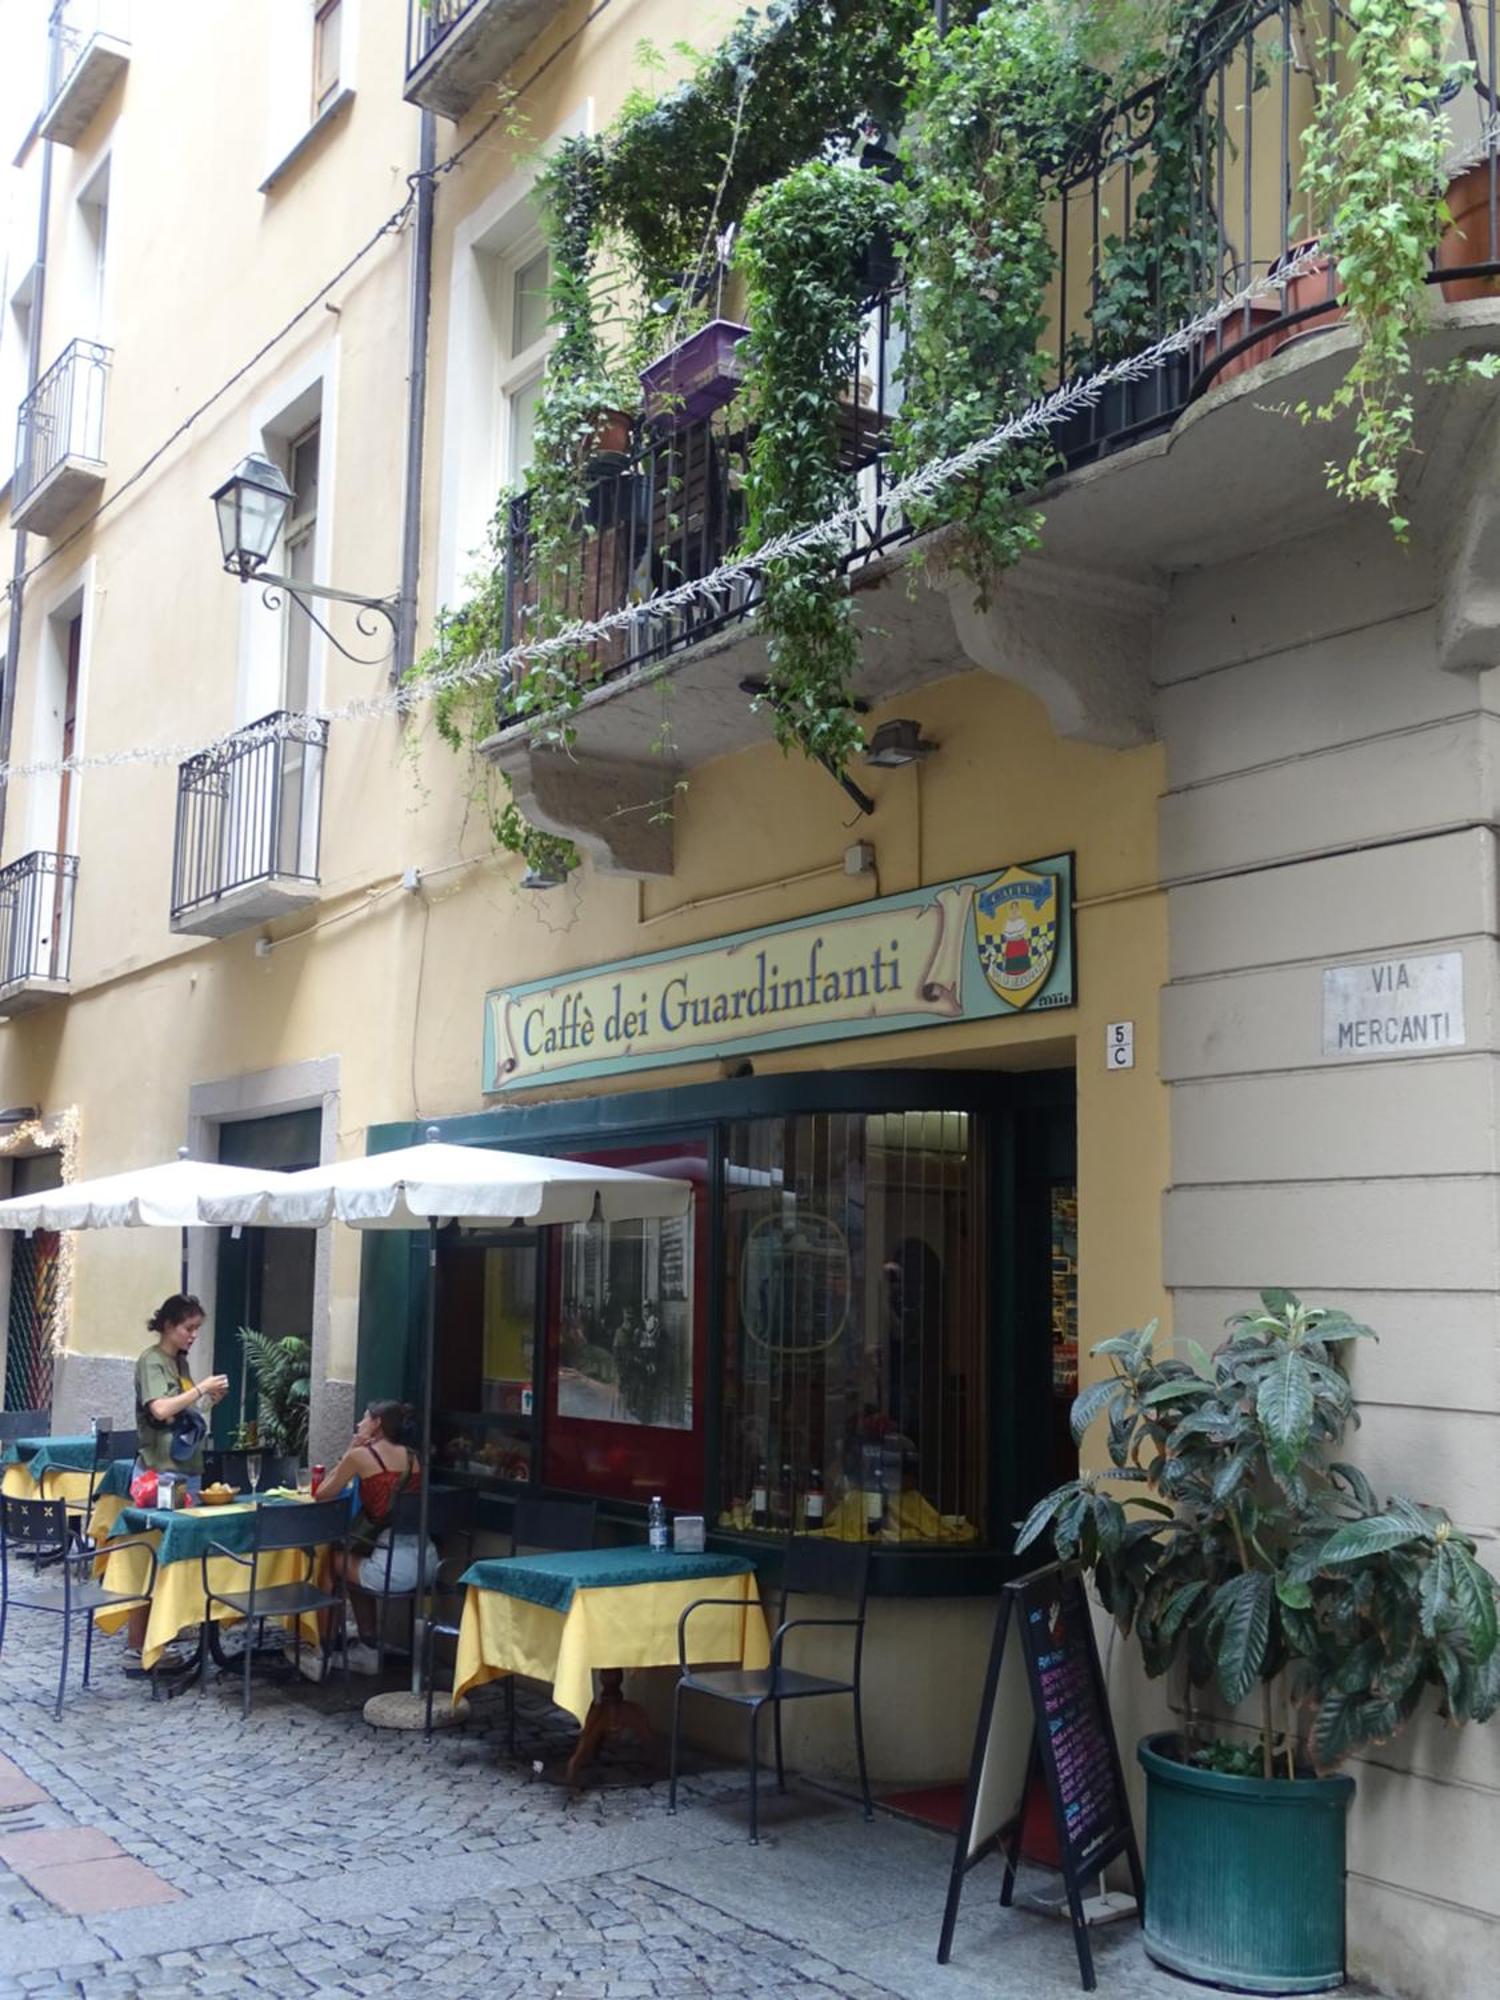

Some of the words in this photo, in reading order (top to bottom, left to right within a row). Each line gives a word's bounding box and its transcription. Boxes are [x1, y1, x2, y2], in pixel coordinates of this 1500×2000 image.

[1371, 963, 1409, 993] VIA
[523, 991, 595, 1057] Caffè
[604, 982, 649, 1043] dei
[659, 937, 903, 1033] Guardinfanti
[1114, 1025, 1125, 1044] 5
[1337, 1011, 1450, 1049] MERCANTI
[1113, 1047, 1126, 1065] C
